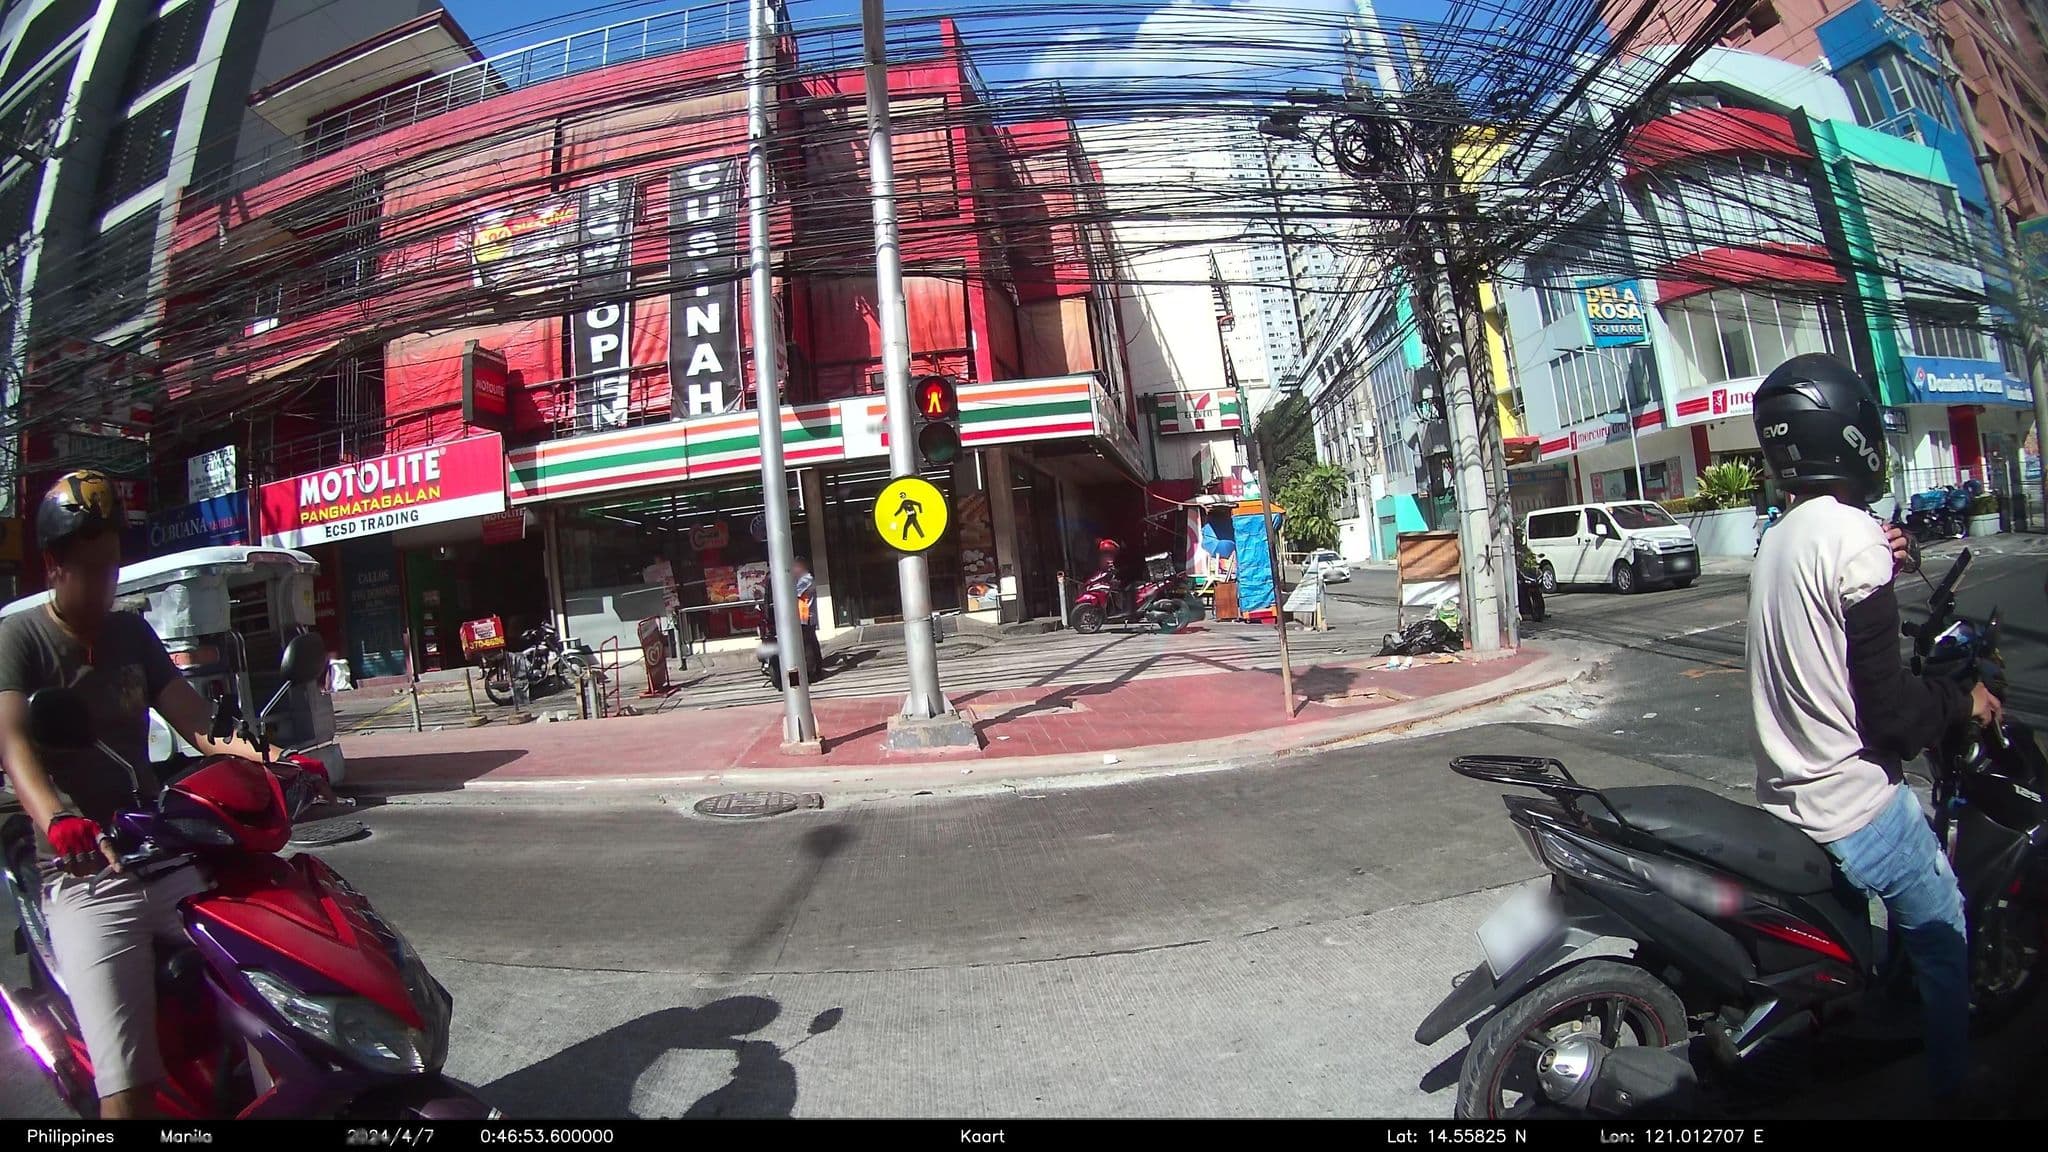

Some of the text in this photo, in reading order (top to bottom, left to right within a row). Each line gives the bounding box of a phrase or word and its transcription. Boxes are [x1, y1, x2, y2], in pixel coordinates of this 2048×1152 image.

[1587, 303, 1642, 320] ROSA
[1592, 324, 1645, 334] SQUARE
[586, 301, 629, 431] OPEN
[1578, 425, 1610, 443] mercury
[1763, 422, 1789, 439] EVO
[202, 447, 234, 464] DENTAL
[1842, 425, 1880, 472] EVO
[204, 458, 235, 473] CLINIC
[300, 448, 440, 508] MOTOLITE
[300, 485, 440, 525] PANGMATAGALAN
[325, 509, 420, 538] ECSD TRADING
